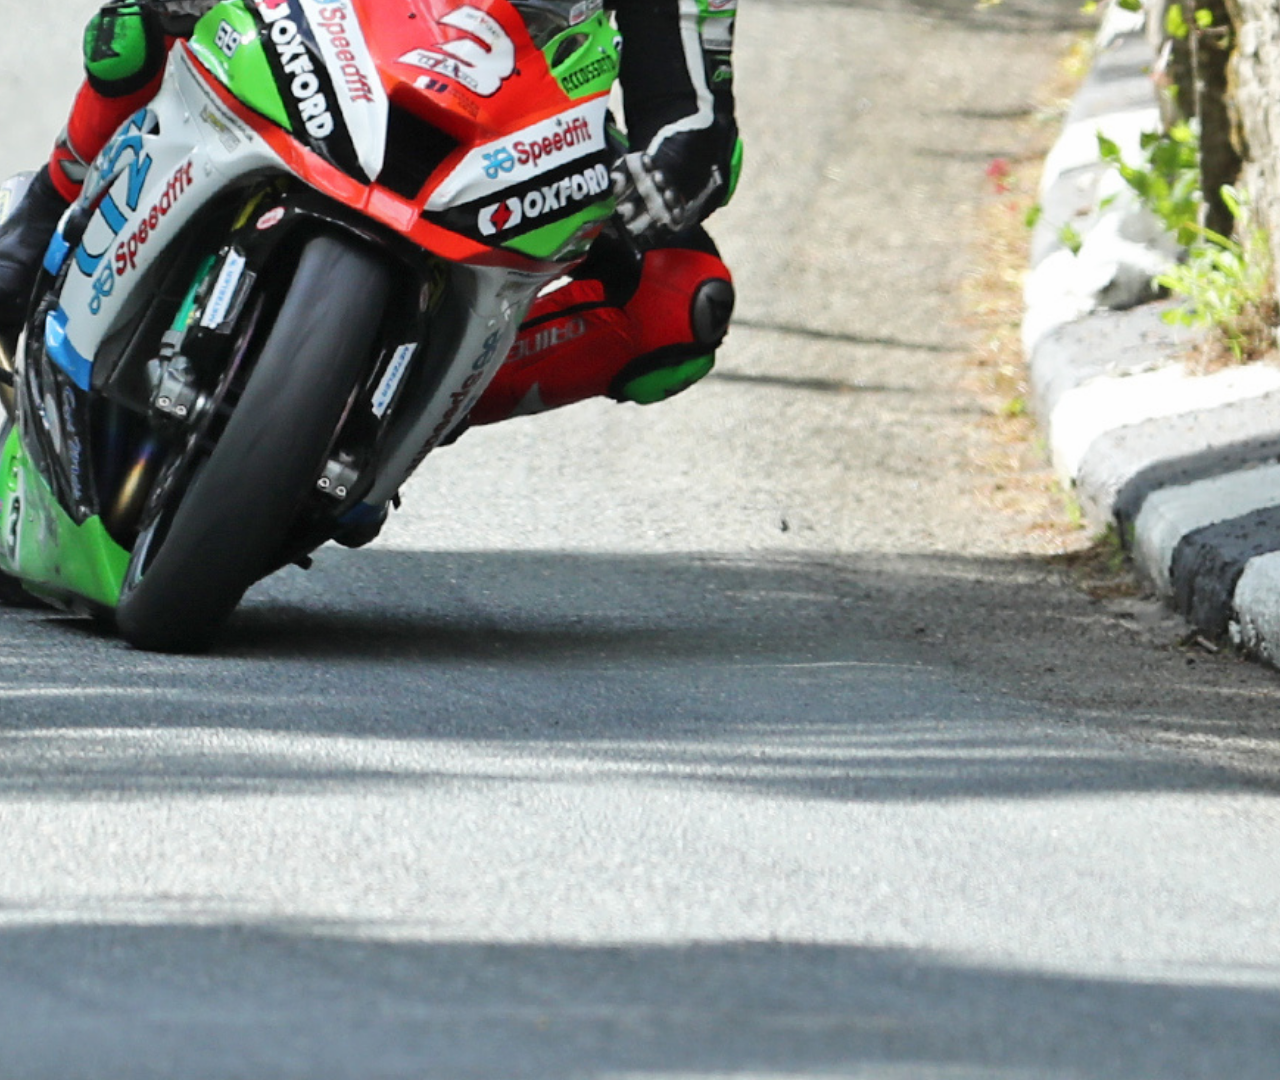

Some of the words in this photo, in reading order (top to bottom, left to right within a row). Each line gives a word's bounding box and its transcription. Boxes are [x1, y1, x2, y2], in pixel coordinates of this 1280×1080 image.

[271, 19, 335, 138] OXFORD
[319, 7, 376, 104] Speedfit
[395, 4, 516, 98] 3
[513, 116, 592, 167] Speedfit
[114, 158, 194, 277] Speedfit
[523, 163, 610, 219] OXFORD
